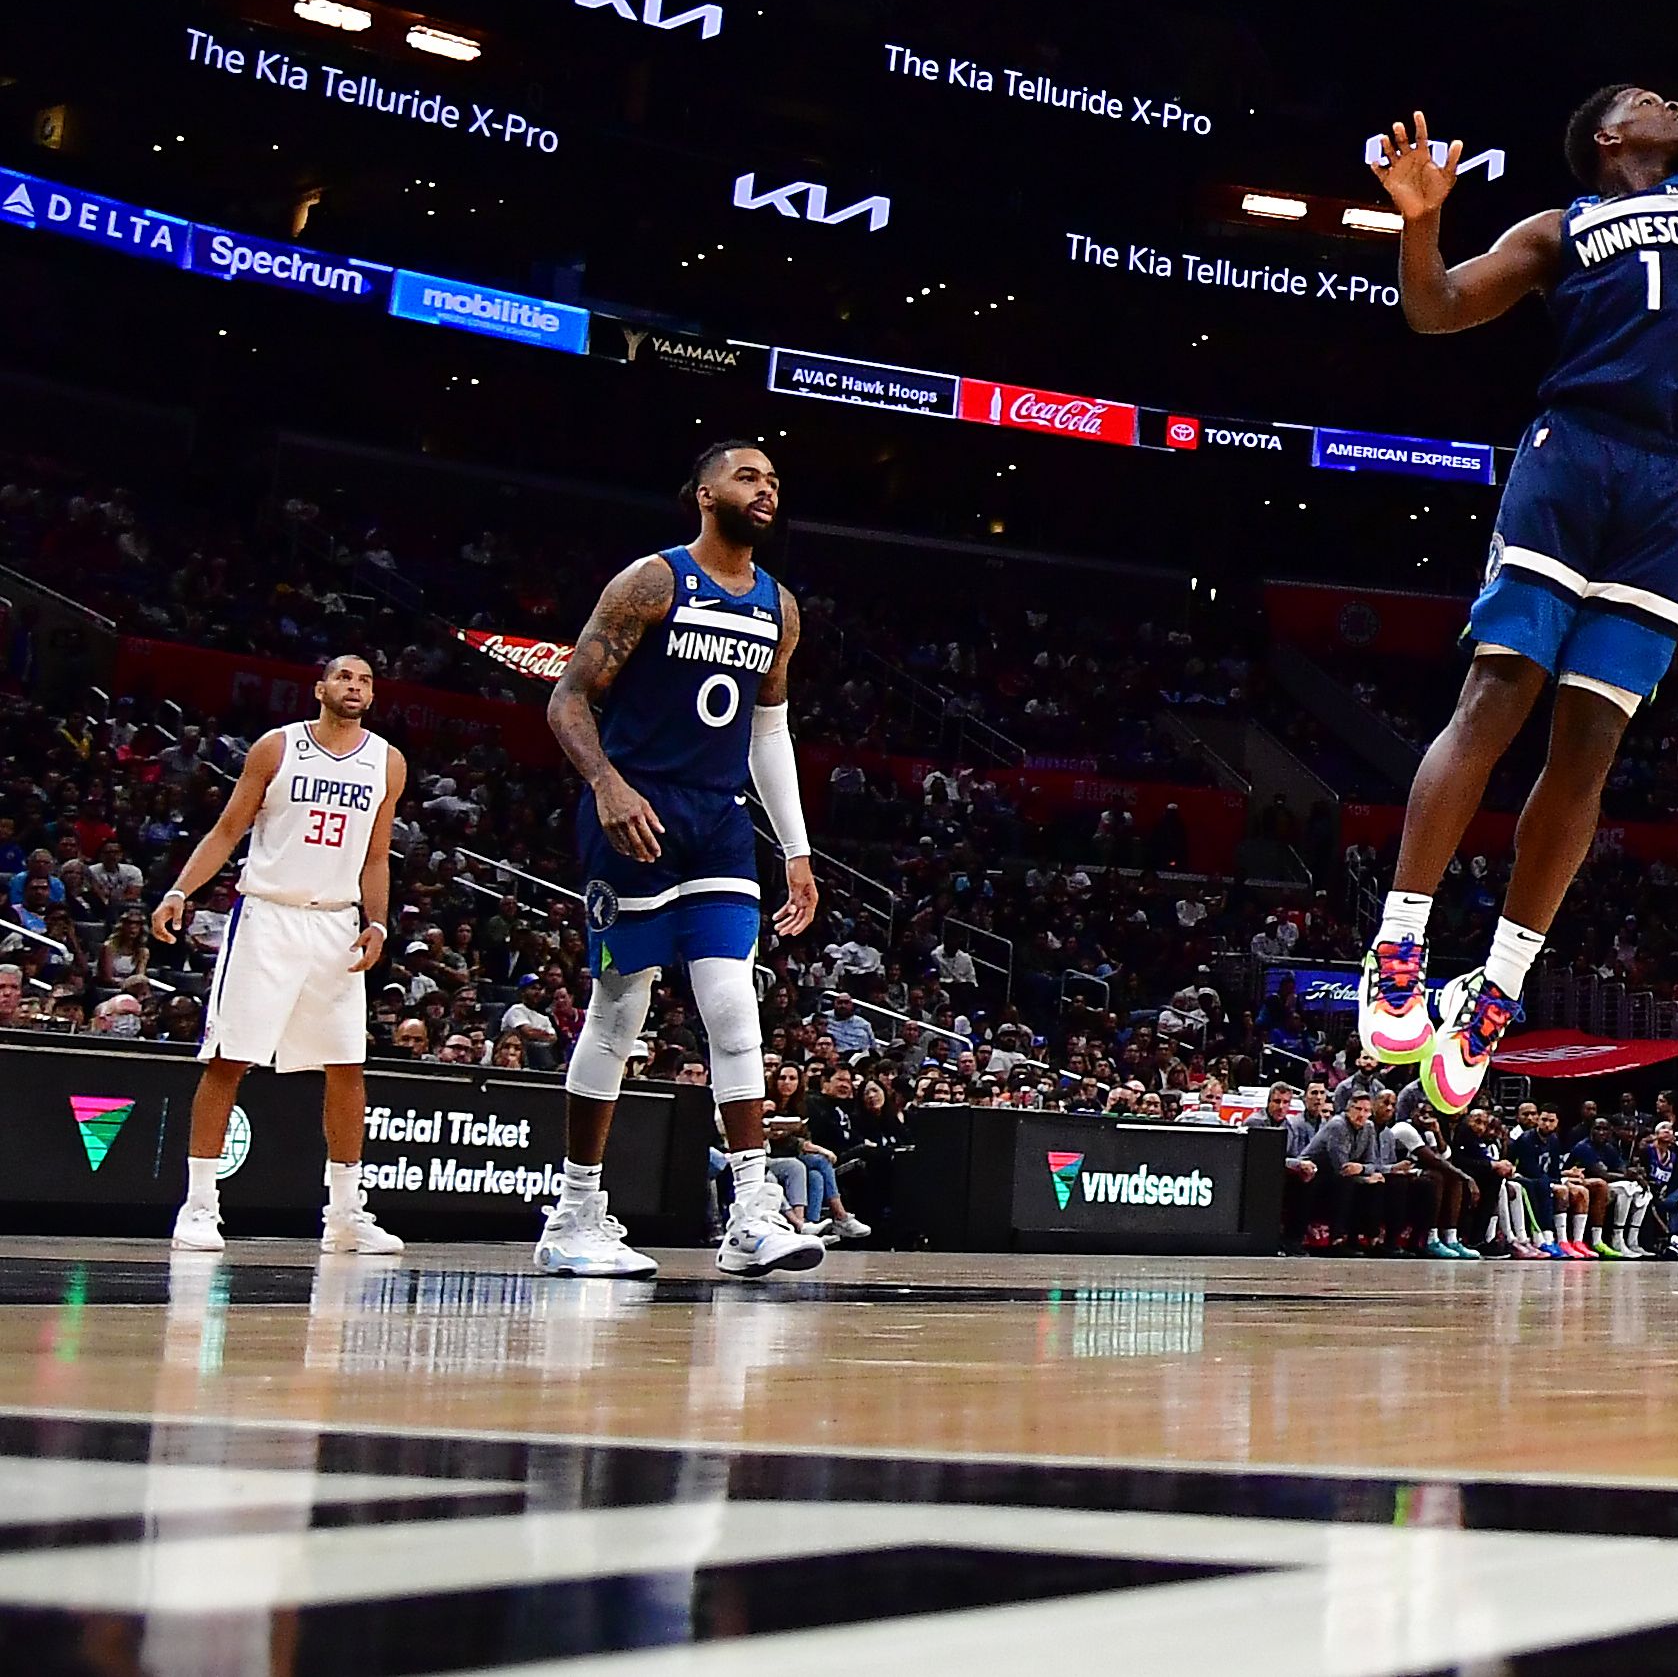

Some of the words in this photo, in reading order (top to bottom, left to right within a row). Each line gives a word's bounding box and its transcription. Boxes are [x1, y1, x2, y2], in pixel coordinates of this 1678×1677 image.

[187, 28, 244, 73] The
[256, 50, 307, 90] Kia
[322, 66, 459, 128] Telluride
[469, 104, 558, 152] X-Pro
[885, 44, 939, 80] The
[949, 58, 993, 91] Kia
[1004, 69, 1123, 118] Telluride
[1131, 97, 1211, 134] X-Pro
[48, 193, 174, 254] DELTA
[210, 234, 362, 294] Spectrum
[1066, 233, 1119, 267] The
[1129, 245, 1171, 277] Kia
[1182, 254, 1307, 295] Telluride
[1316, 271, 1399, 307] X-Pro
[1639, 250, 1660, 311] 1
[423, 285, 560, 333] mobilitie
[792, 368, 837, 388] AVAC
[842, 375, 885, 397] Hawk
[889, 382, 938, 404] Hoops
[1010, 393, 1108, 435] Coca-Cola
[1205, 428, 1282, 452] TOYOTA
[1326, 442, 1408, 463] AMERICAN
[1411, 452, 1482, 471] EXPRESS
[666, 630, 773, 674] MINNESOTA
[697, 674, 739, 727] 0
[291, 775, 373, 812] CLIPPERS
[304, 810, 347, 848] 33
[448, 1111, 531, 1149] Ticket
[1082, 1165, 1213, 1208] vividseats
